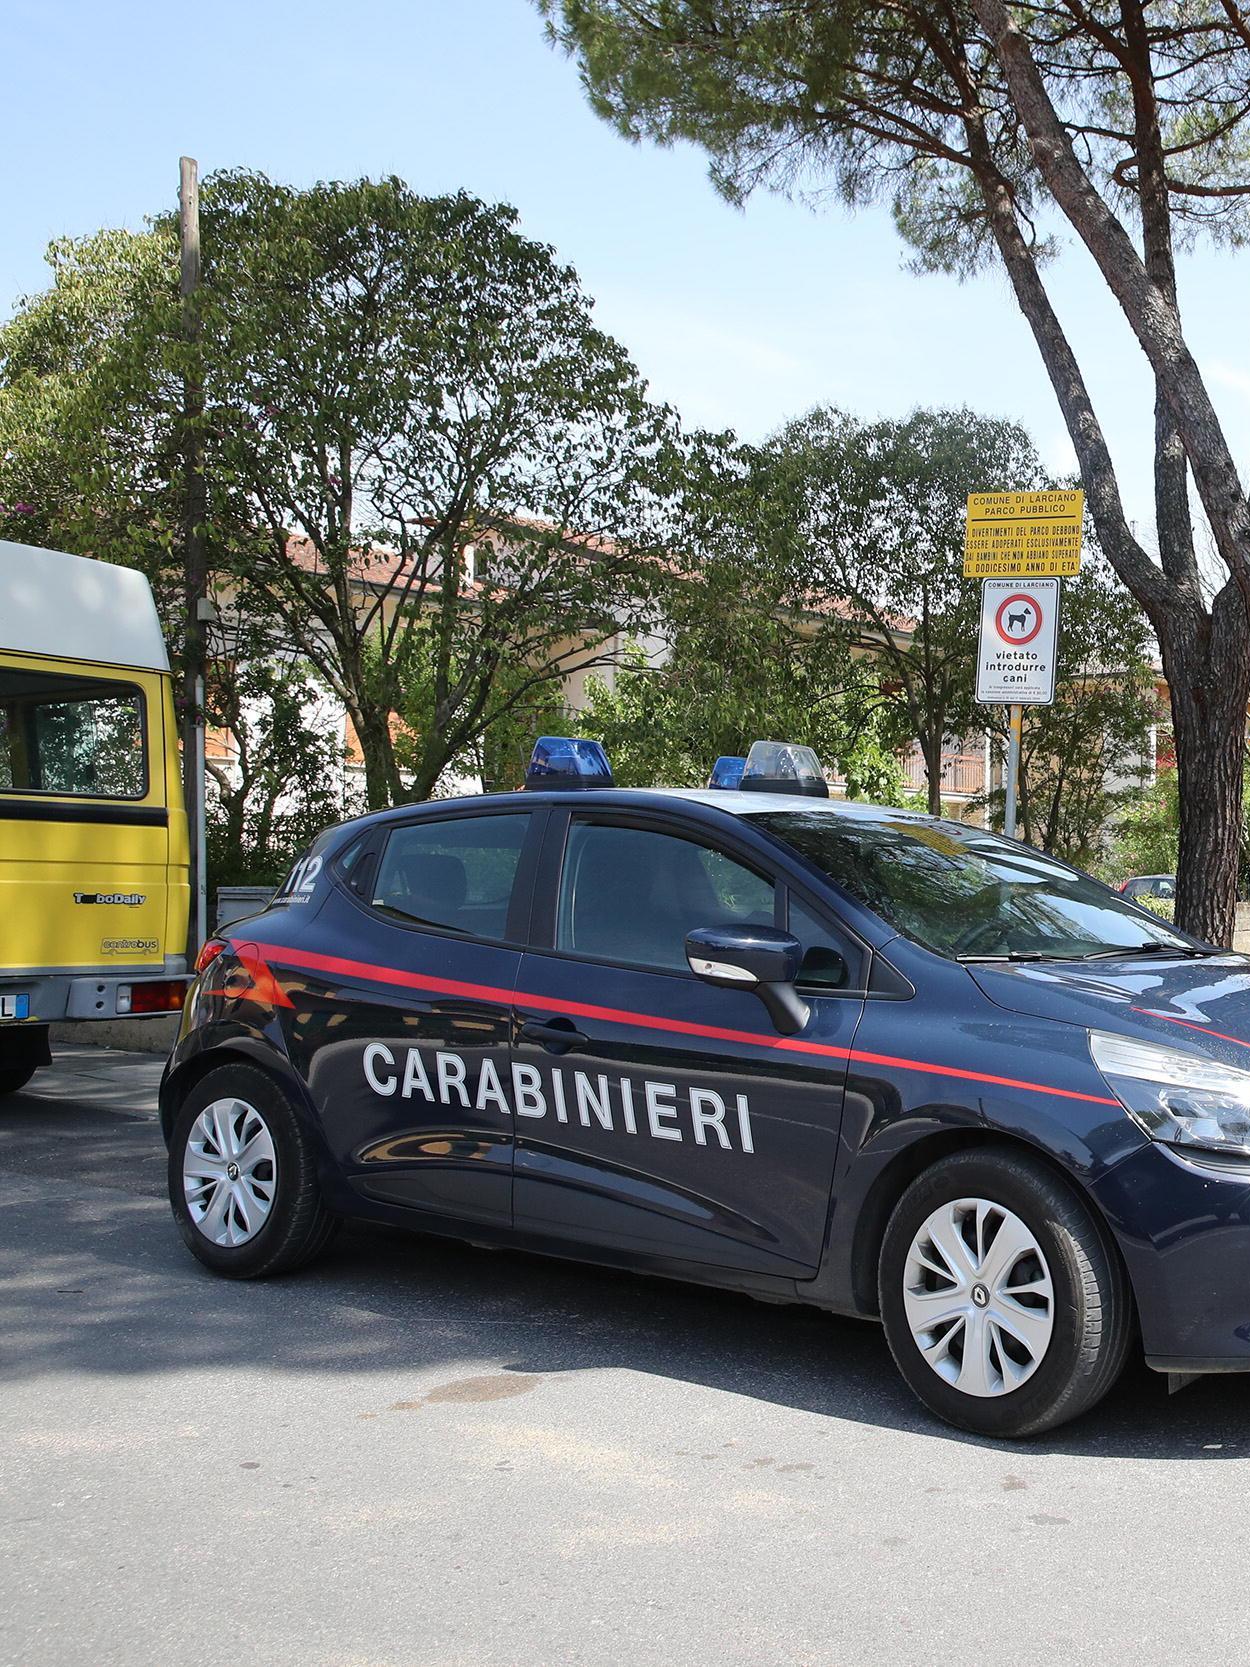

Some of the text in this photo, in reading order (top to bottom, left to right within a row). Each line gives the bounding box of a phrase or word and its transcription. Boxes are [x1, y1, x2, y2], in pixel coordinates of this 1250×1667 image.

[973, 493, 1077, 505] COMUNE DI LARCIANO
[985, 504, 1066, 515] PARCO PUBBLICO
[972, 527, 1013, 537] DIVERTIMENTI
[1016, 526, 1026, 536] DEL
[1030, 526, 1049, 536] PARCO
[1052, 525, 1079, 535] DEBBONO
[966, 537, 1078, 549] ESSERE ADOPERATI ESCLUSIVAMENTE
[965, 549, 1078, 561] DAI BAMBINI CHE NON ABBIANO SUPERATO
[964, 564, 971, 573] IL
[975, 562, 1021, 573] DODICESIMO
[1026, 562, 1046, 572] ANNO
[1049, 561, 1058, 571] DI
[995, 650, 1038, 660] vietato
[985, 661, 1046, 671] introdurre
[1003, 673, 1027, 683] cani
[284, 855, 323, 893] 112
[74, 893, 146, 904] TboDaily
[363, 1042, 754, 1154] CARABINIERI
